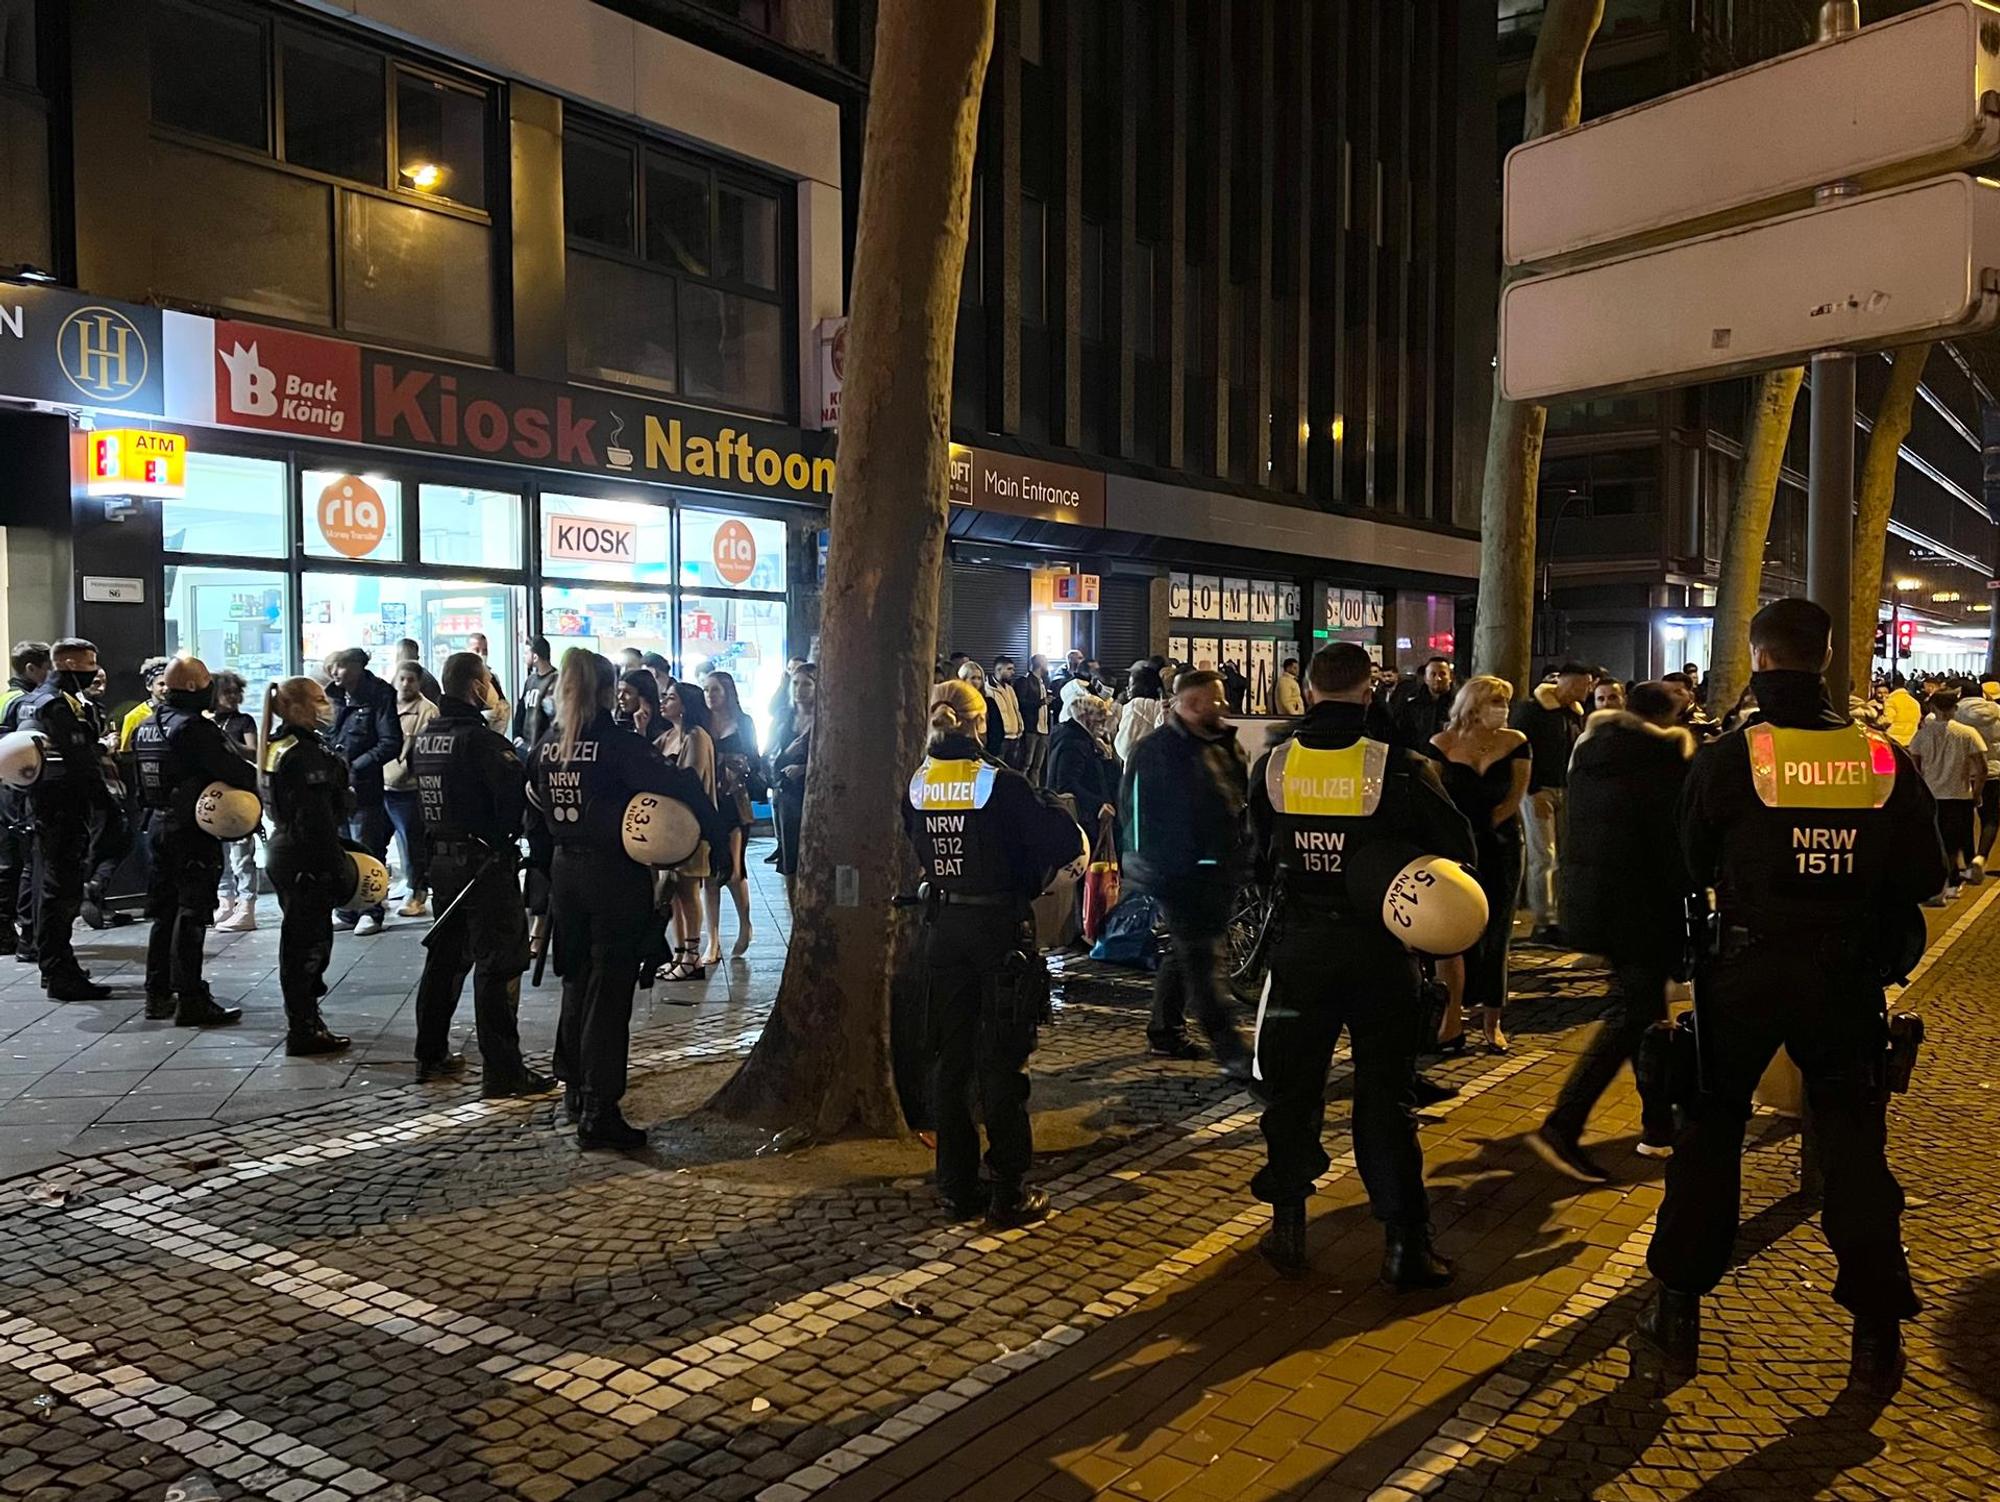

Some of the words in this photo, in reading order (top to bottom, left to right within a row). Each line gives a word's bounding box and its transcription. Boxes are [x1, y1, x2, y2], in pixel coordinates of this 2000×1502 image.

[285, 374, 338, 401] Back
[282, 399, 344, 433] König
[373, 363, 598, 466] Kiosk
[644, 415, 836, 494] Naftoon
[136, 435, 174, 452] ATM
[950, 461, 970, 482] OFT
[985, 469, 1018, 498] Main
[1023, 476, 1079, 508] Entrance
[326, 486, 379, 529] ria
[558, 525, 630, 556] KIOSK
[719, 528, 752, 561] ria
[415, 736, 454, 754] POLIZEI
[419, 775, 442, 789] NRW
[548, 772, 581, 787] NRW
[1784, 761, 1867, 785] POLIZEI
[420, 790, 443, 805] 1531
[550, 788, 582, 804] 1531
[923, 782, 975, 802] POLIZEI
[1290, 777, 1355, 799] POLIZEI
[926, 816, 965, 833] NRW
[932, 837, 964, 855] 1512
[1294, 831, 1345, 851] NRW
[1792, 827, 1857, 850] NRW
[934, 859, 964, 876] BAT
[1302, 853, 1342, 873] 1512
[1795, 853, 1854, 875] 1511
[1388, 873, 1411, 907] NRW
